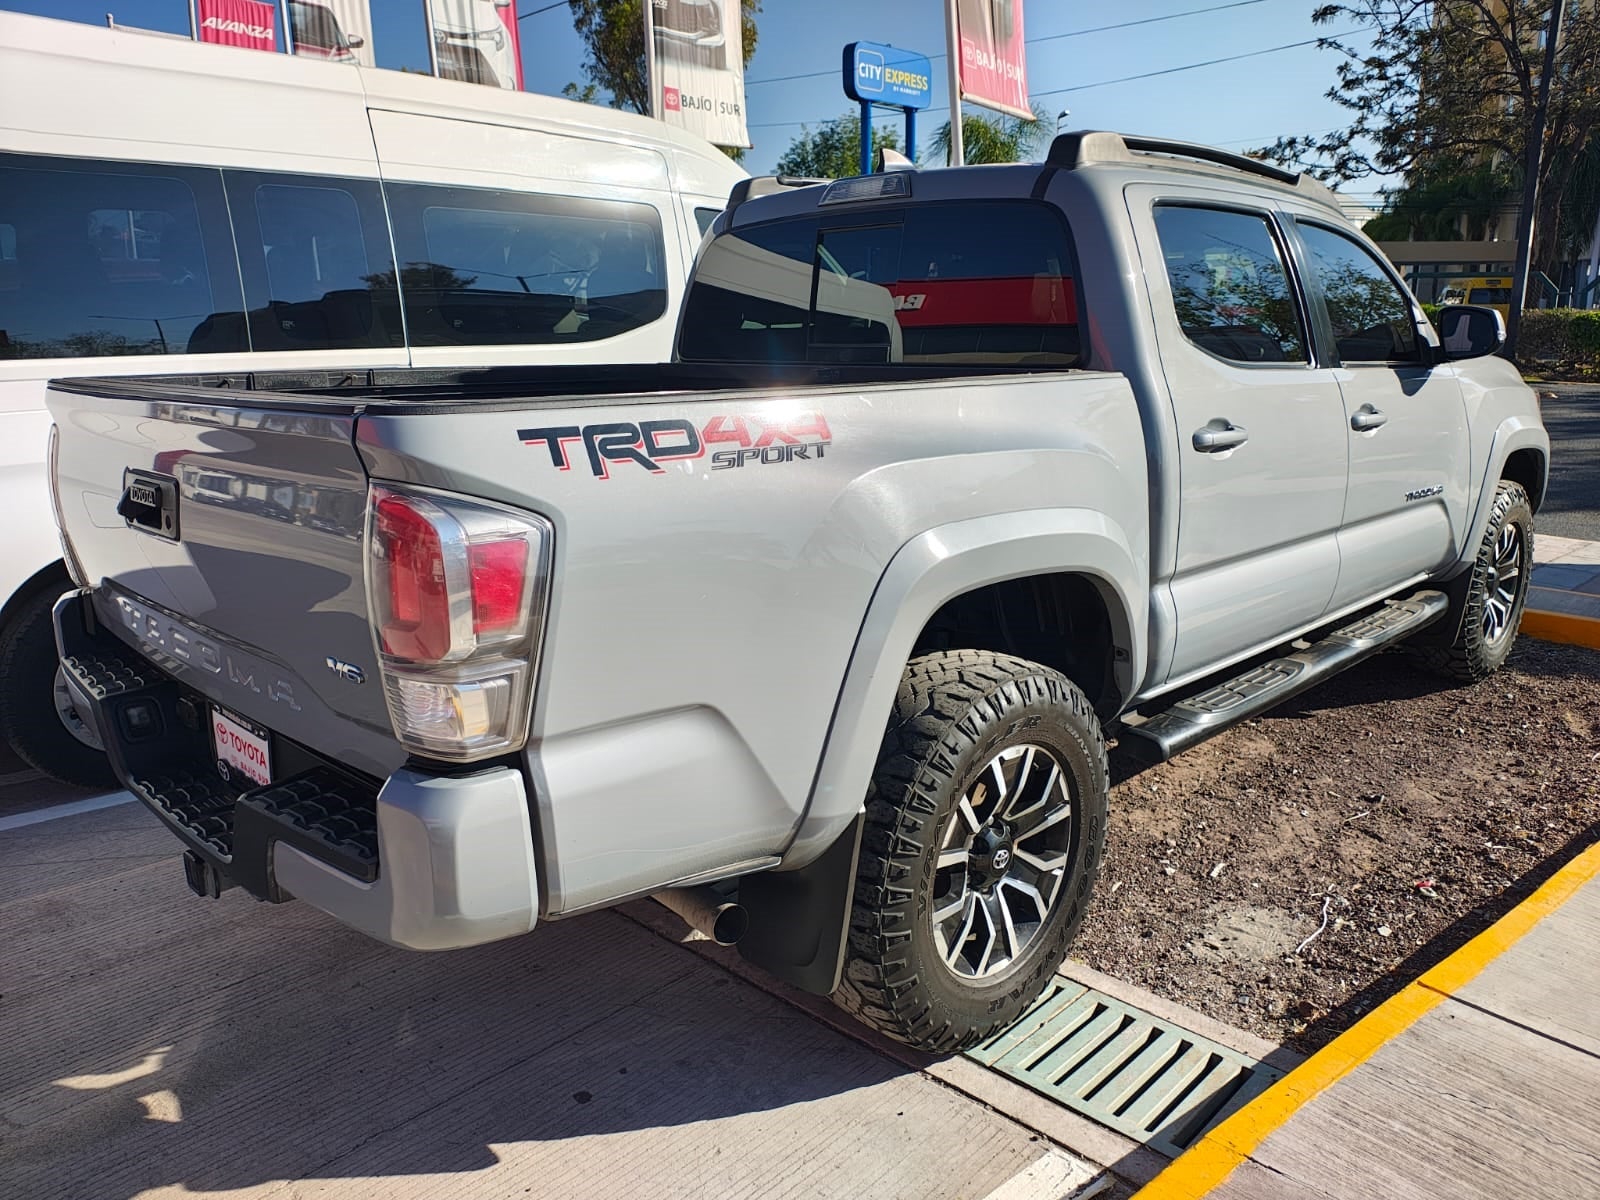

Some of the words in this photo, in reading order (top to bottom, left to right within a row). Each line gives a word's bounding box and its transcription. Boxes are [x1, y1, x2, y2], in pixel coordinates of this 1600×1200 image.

[201, 16, 274, 40] AVANZA
[859, 62, 882, 81] CITY
[885, 68, 928, 91] EXPRESS
[681, 94, 712, 112] BAJÍO
[720, 101, 741, 117] SUR
[516, 418, 706, 480] TRD
[712, 441, 832, 471] SPORT
[130, 486, 156, 506] TOYOTA
[116, 596, 302, 712] TACOMA
[326, 656, 366, 684] V6
[229, 731, 268, 770] TOYOTA
